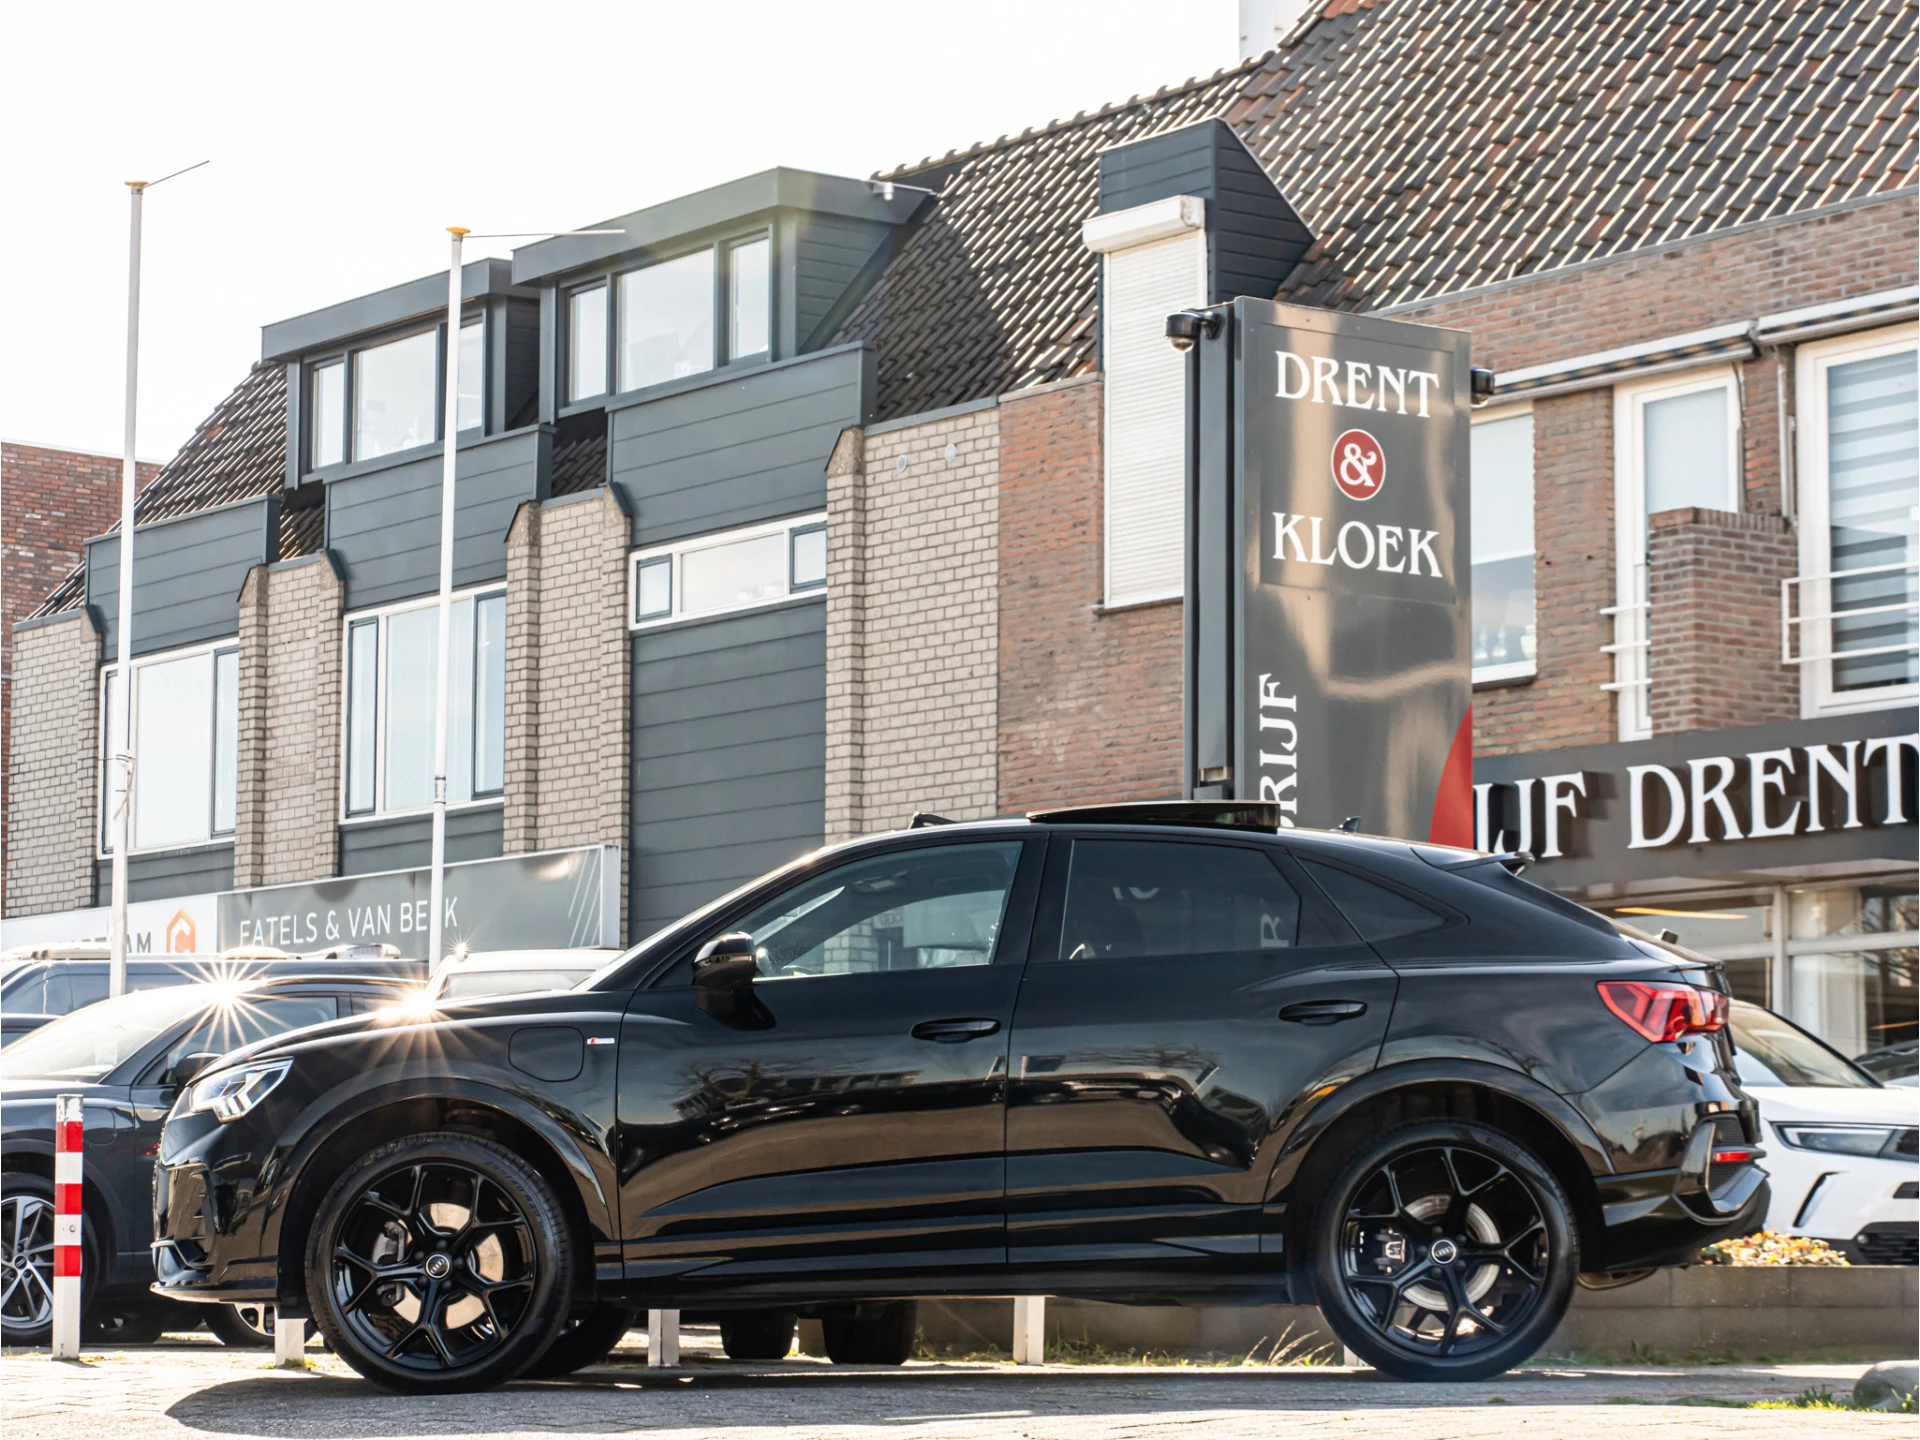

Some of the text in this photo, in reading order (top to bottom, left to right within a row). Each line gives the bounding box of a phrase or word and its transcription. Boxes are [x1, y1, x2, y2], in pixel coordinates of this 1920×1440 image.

[1275, 350, 1440, 418] DRENT
[1338, 441, 1378, 488] &
[1272, 512, 1443, 578] KLOEK
[1258, 672, 1298, 828] RIJF
[1625, 733, 1919, 849] DRENT
[325, 909, 340, 941] &
[348, 903, 391, 938] VAN
[400, 896, 458, 933] BEK
